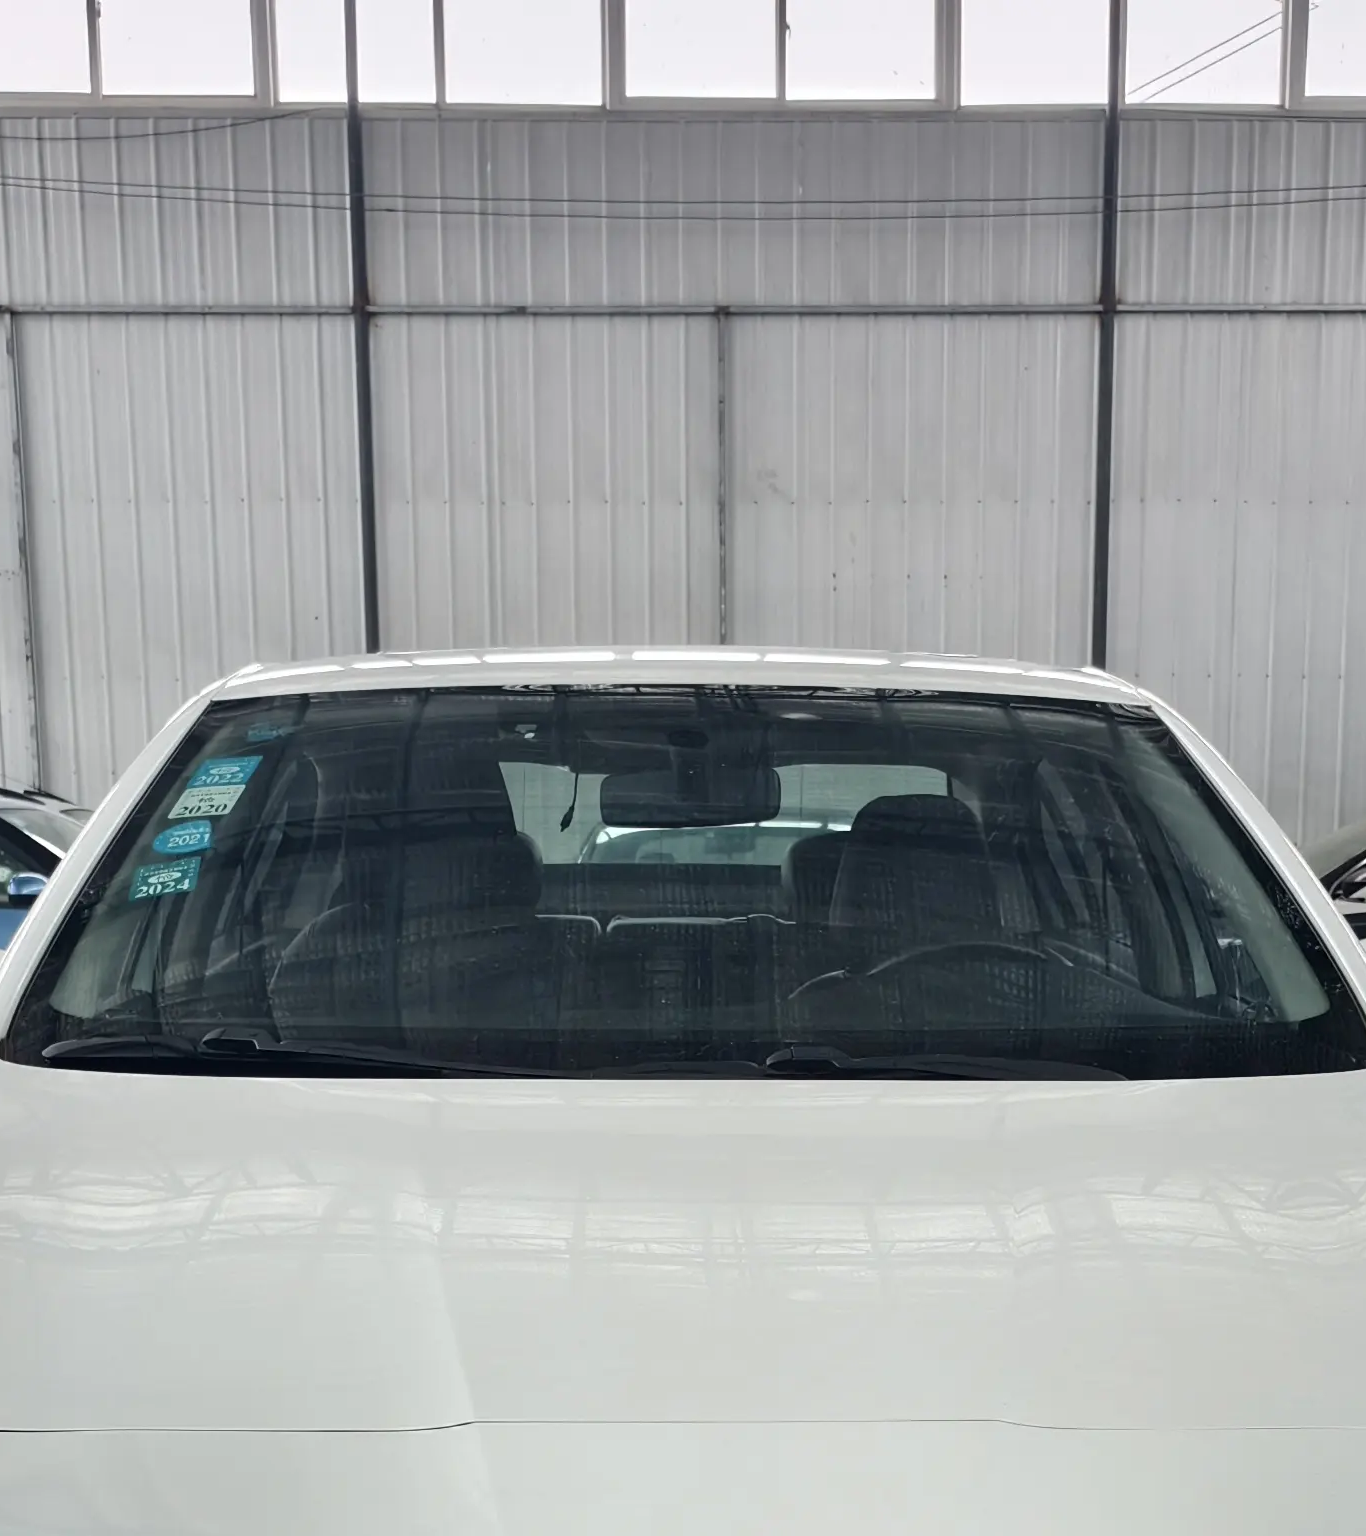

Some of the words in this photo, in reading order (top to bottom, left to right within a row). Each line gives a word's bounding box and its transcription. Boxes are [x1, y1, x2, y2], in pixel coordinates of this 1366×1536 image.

[192, 772, 244, 786] 2022
[175, 803, 228, 816] 2020
[167, 833, 211, 848] 2021
[134, 878, 190, 899] 2024
